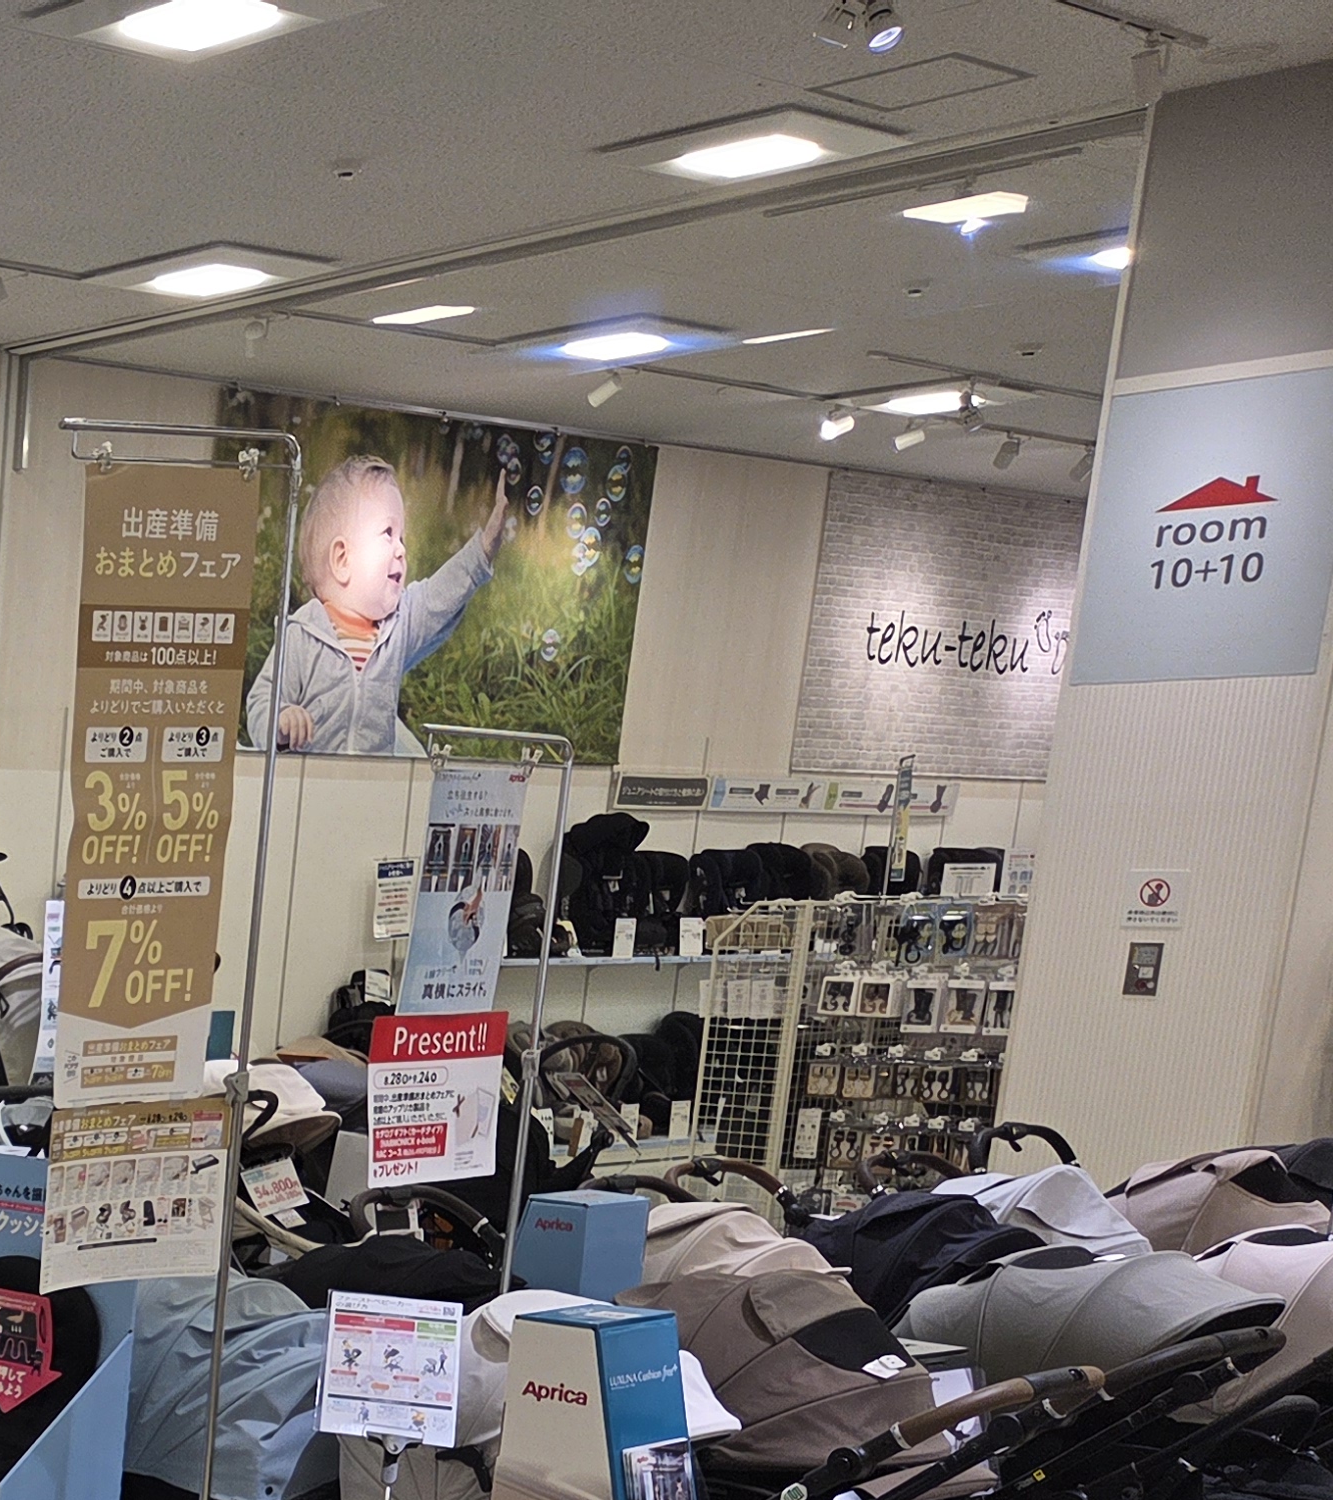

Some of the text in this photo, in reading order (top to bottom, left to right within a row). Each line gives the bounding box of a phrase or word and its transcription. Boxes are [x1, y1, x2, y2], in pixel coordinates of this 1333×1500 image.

[121, 507, 219, 542] 出産準備
[1154, 514, 1267, 548] room
[95, 546, 241, 579] おまとめフェア
[1150, 551, 1265, 590] 10+10
[866, 609, 1030, 676] teku-teku
[90, 700, 225, 715] よりどりでご購入いただくと
[84, 770, 147, 831] 3%
[161, 770, 219, 831] 5%
[82, 834, 141, 865] OFF!
[156, 834, 213, 863] OFF!
[85, 919, 162, 1008] 7%
[124, 968, 194, 1005] OFF!
[422, 982, 487, 1000] 真横にスライド。
[393, 1022, 488, 1056] Present!!
[535, 1217, 574, 1232] Aprica
[522, 1380, 588, 1406] Aprica
